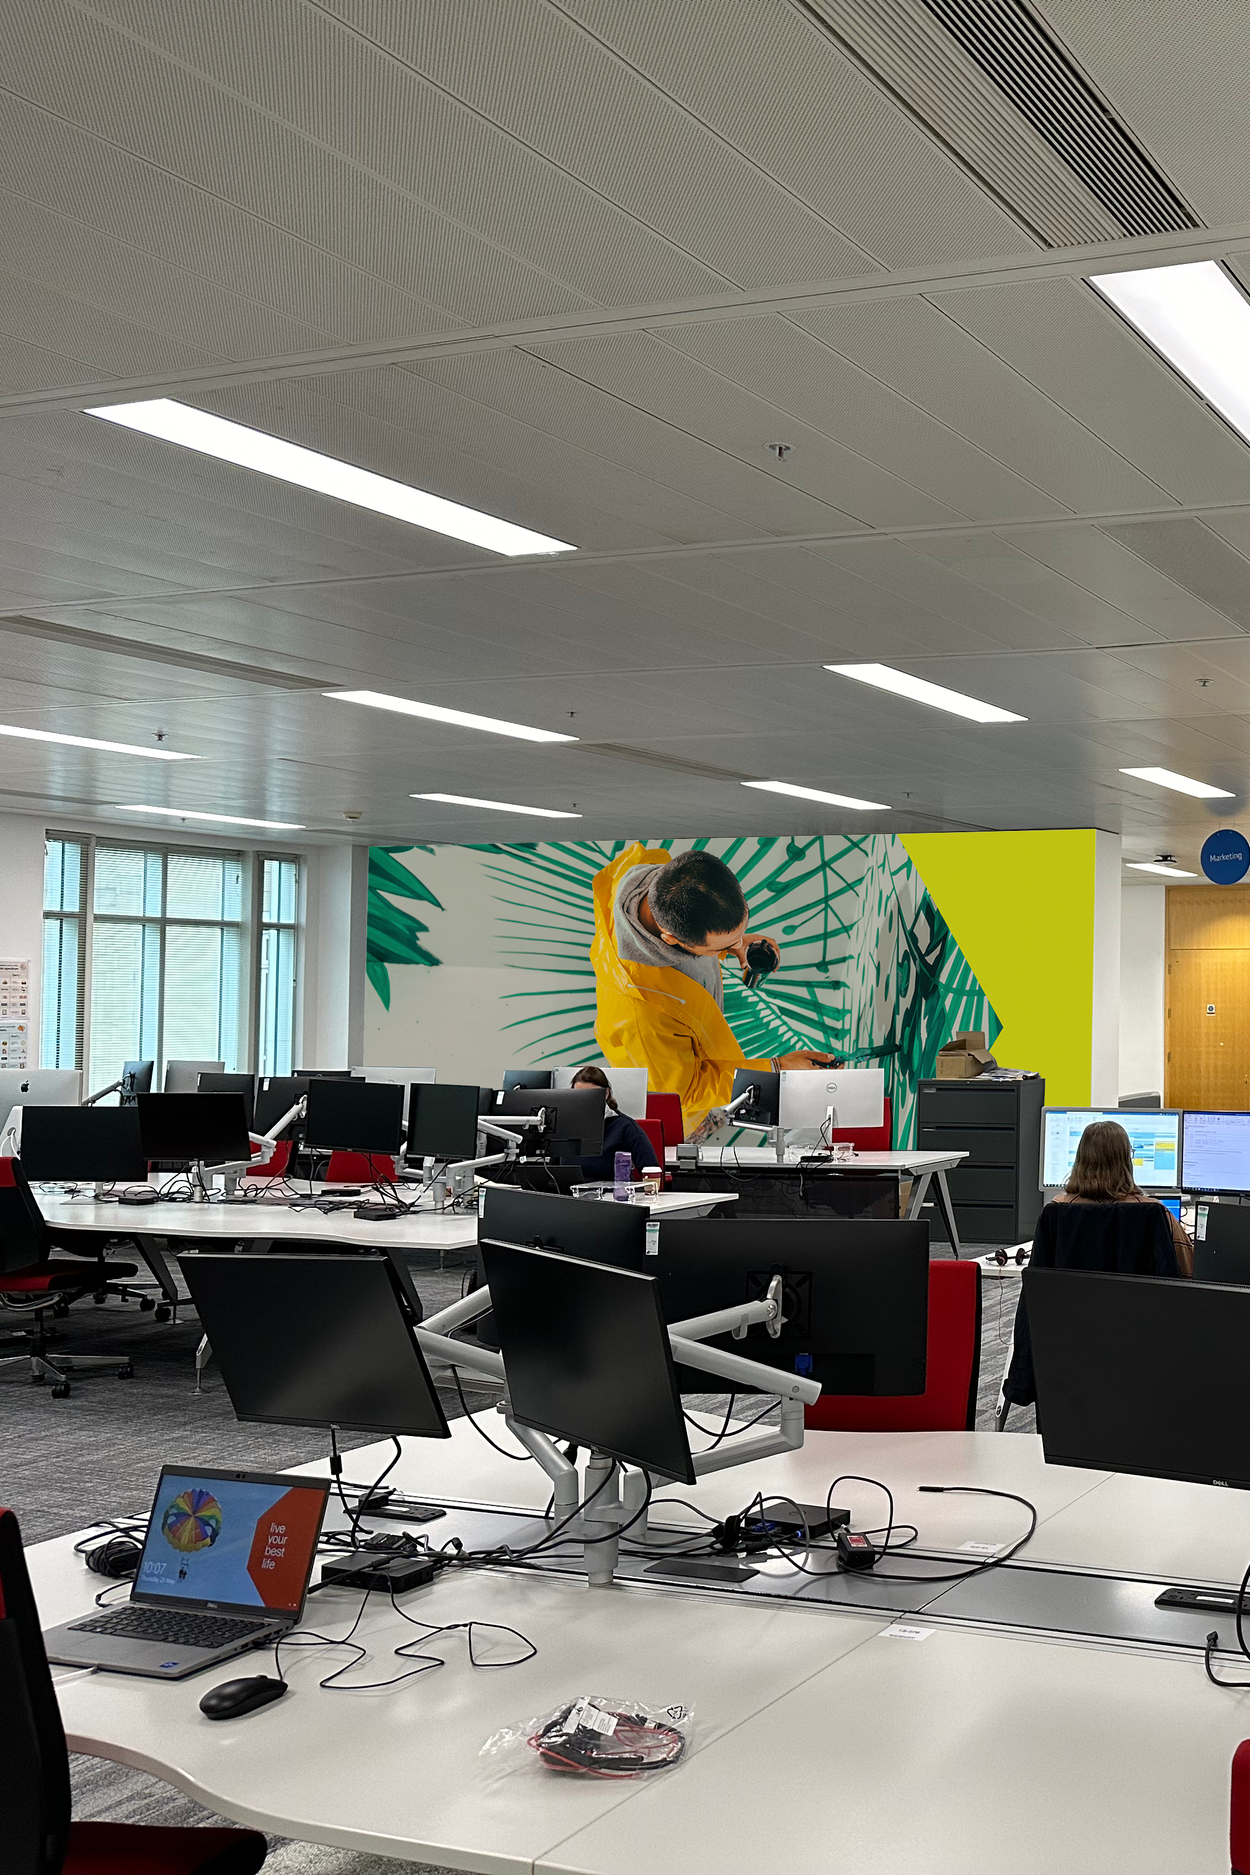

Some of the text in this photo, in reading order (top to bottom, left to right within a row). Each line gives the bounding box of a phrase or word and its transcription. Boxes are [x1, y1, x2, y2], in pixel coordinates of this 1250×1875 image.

[1209, 852, 1242, 862] Marketing
[1212, 1479, 1229, 1487] DELL
[270, 1522, 286, 1534] live
[267, 1534, 288, 1545] your
[264, 1546, 285, 1557] best
[143, 1561, 167, 1574] 10:07
[261, 1557, 275, 1570] life
